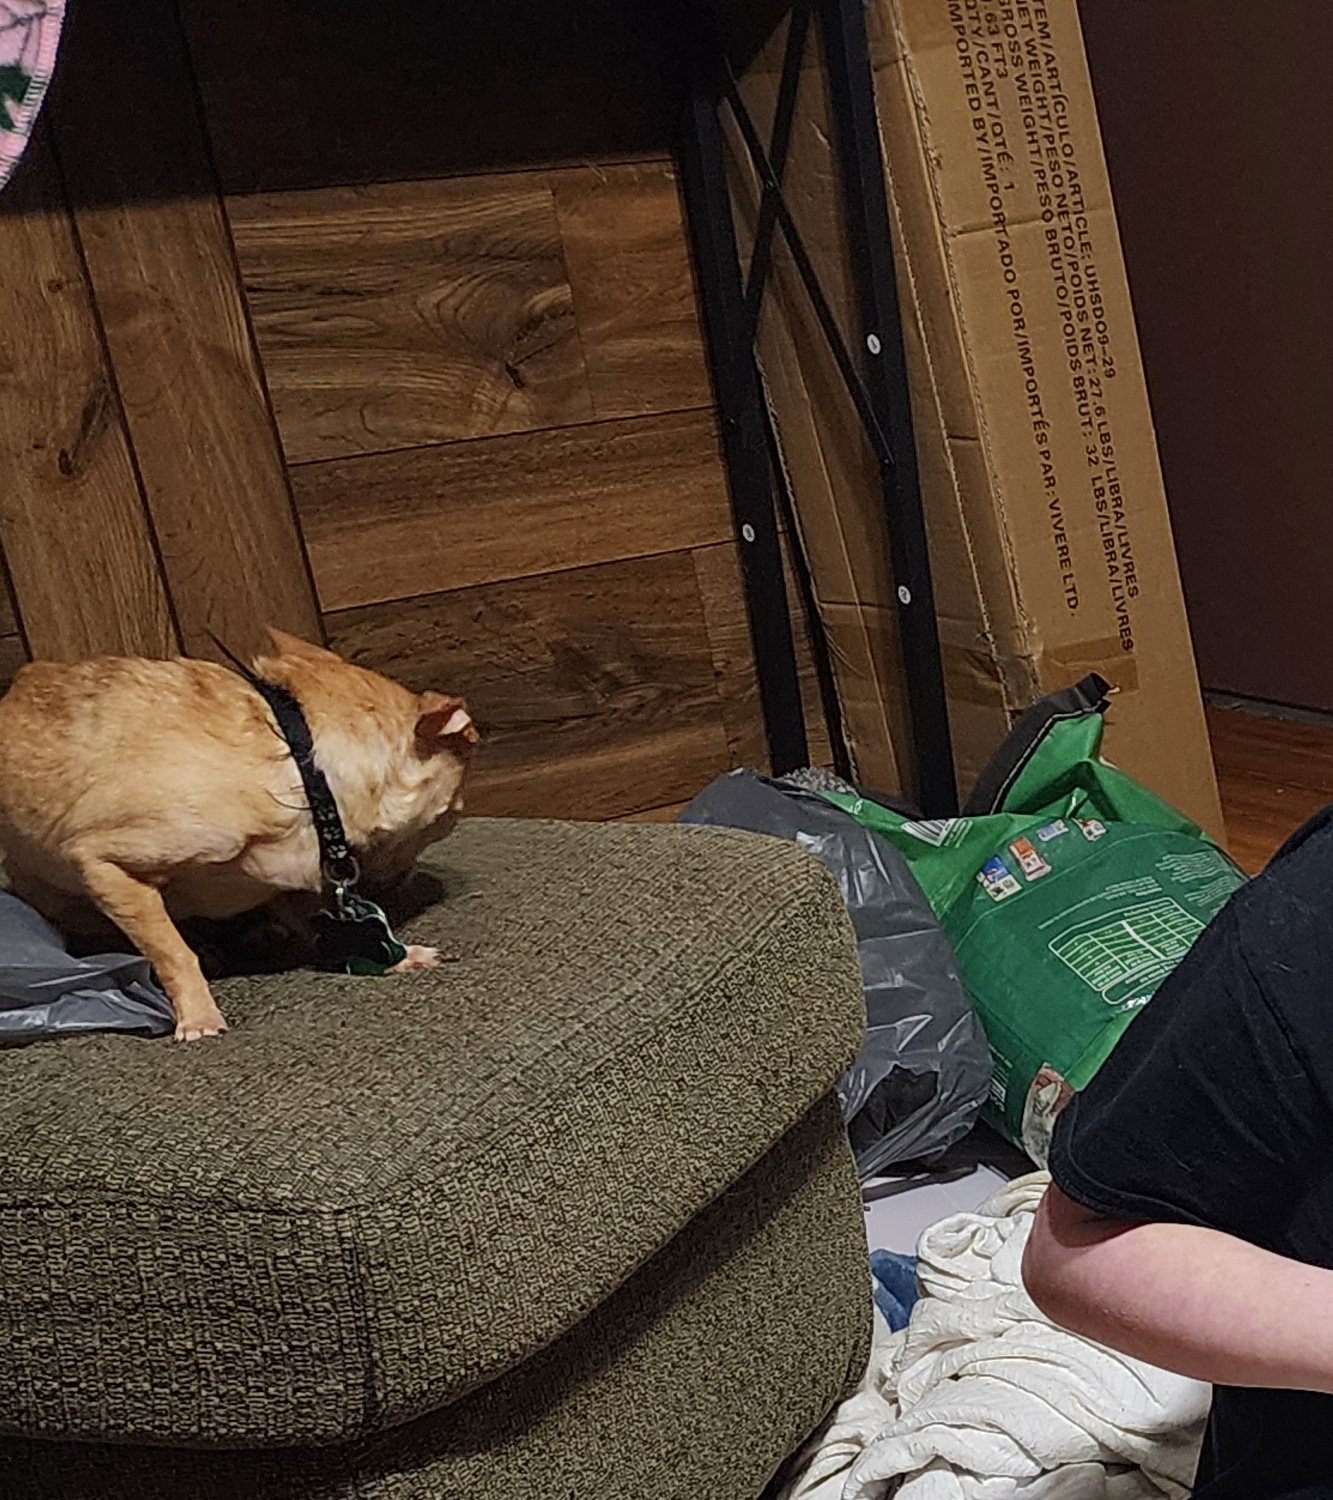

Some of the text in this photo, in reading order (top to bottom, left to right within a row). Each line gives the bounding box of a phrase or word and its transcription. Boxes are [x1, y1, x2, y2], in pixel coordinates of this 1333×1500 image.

[990, 41, 1008, 79] FT3
[1031, 0, 1093, 260] TEM/ARTÍCULO/ARTICLE:
[1085, 445, 1100, 468] 32
[1097, 421, 1139, 599] LBS/LIBRA/LIVRES
[1048, 498, 1073, 570] VIVERE
[1091, 475, 1135, 652] LBS/LIBRA/LIVRES
